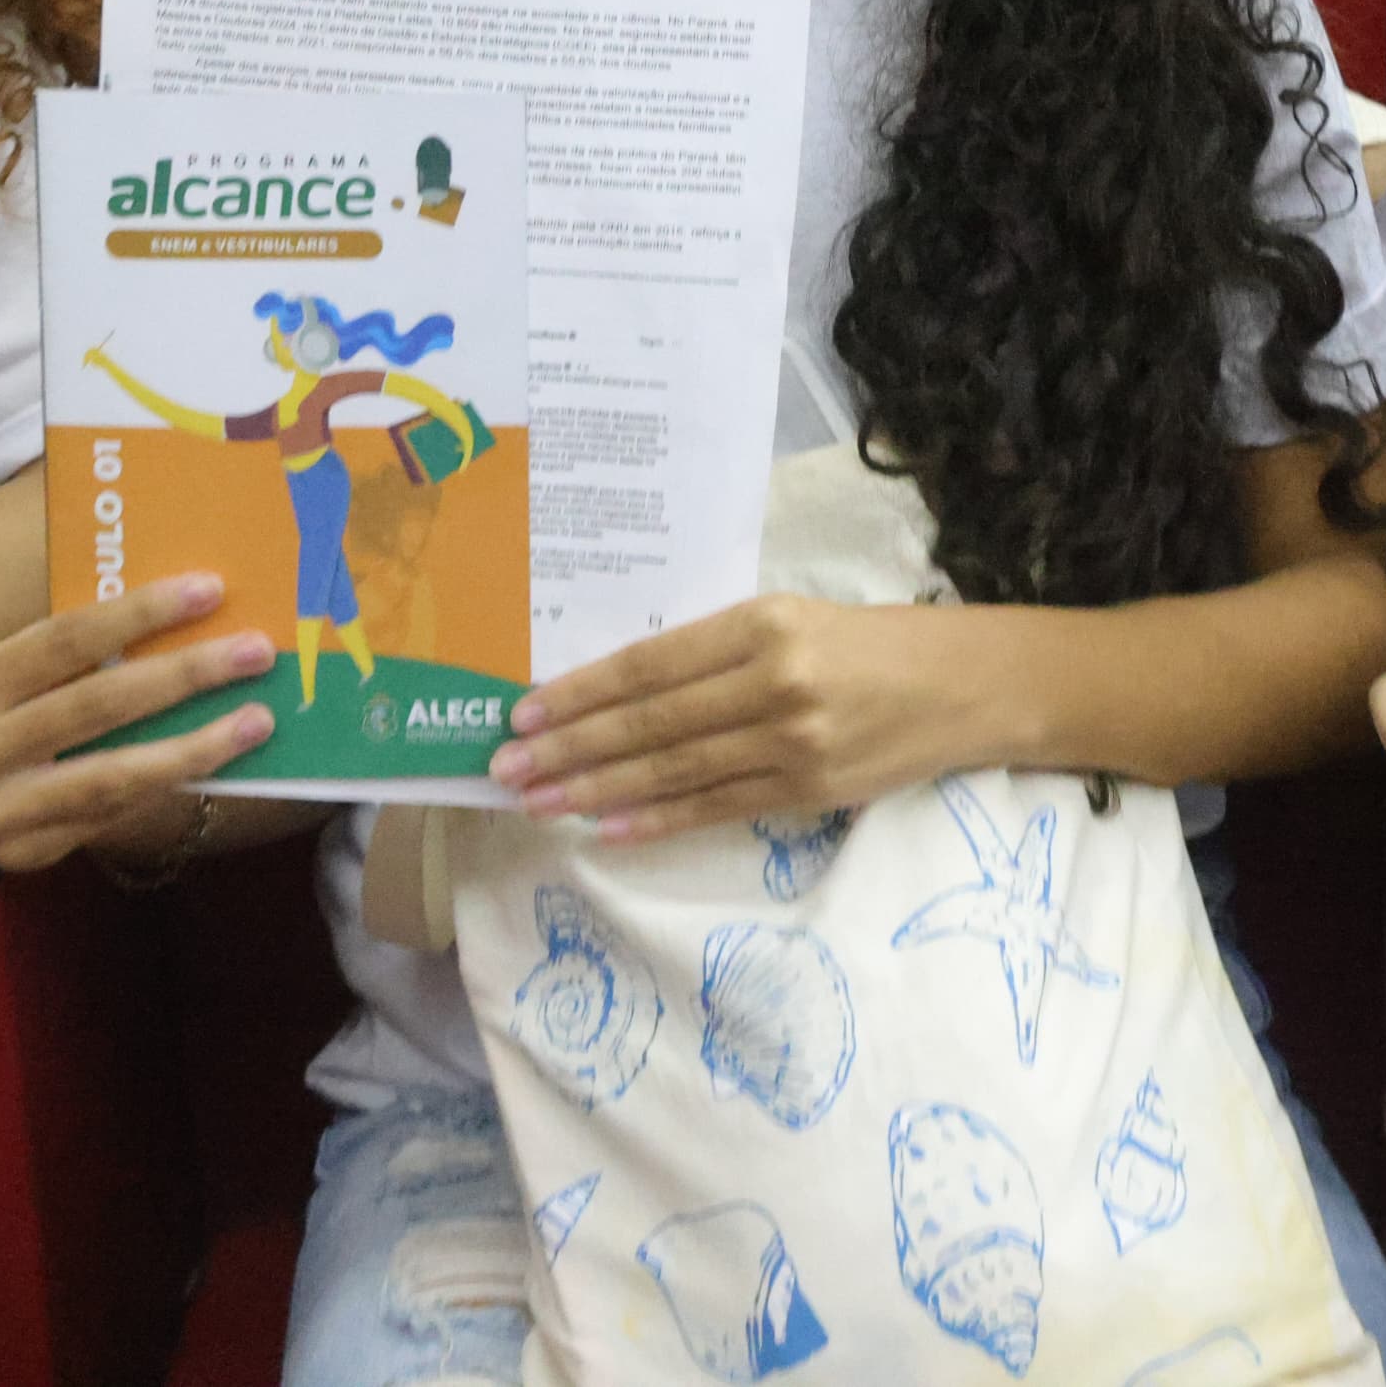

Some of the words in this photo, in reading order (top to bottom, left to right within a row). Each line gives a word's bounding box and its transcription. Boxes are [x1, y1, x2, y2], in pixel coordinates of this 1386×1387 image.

[188, 153, 369, 169] PROGRAMA
[107, 158, 376, 218] alcance
[215, 237, 339, 254] VESTIBULARES
[93, 438, 123, 483] 01
[405, 697, 502, 727] ALECE
